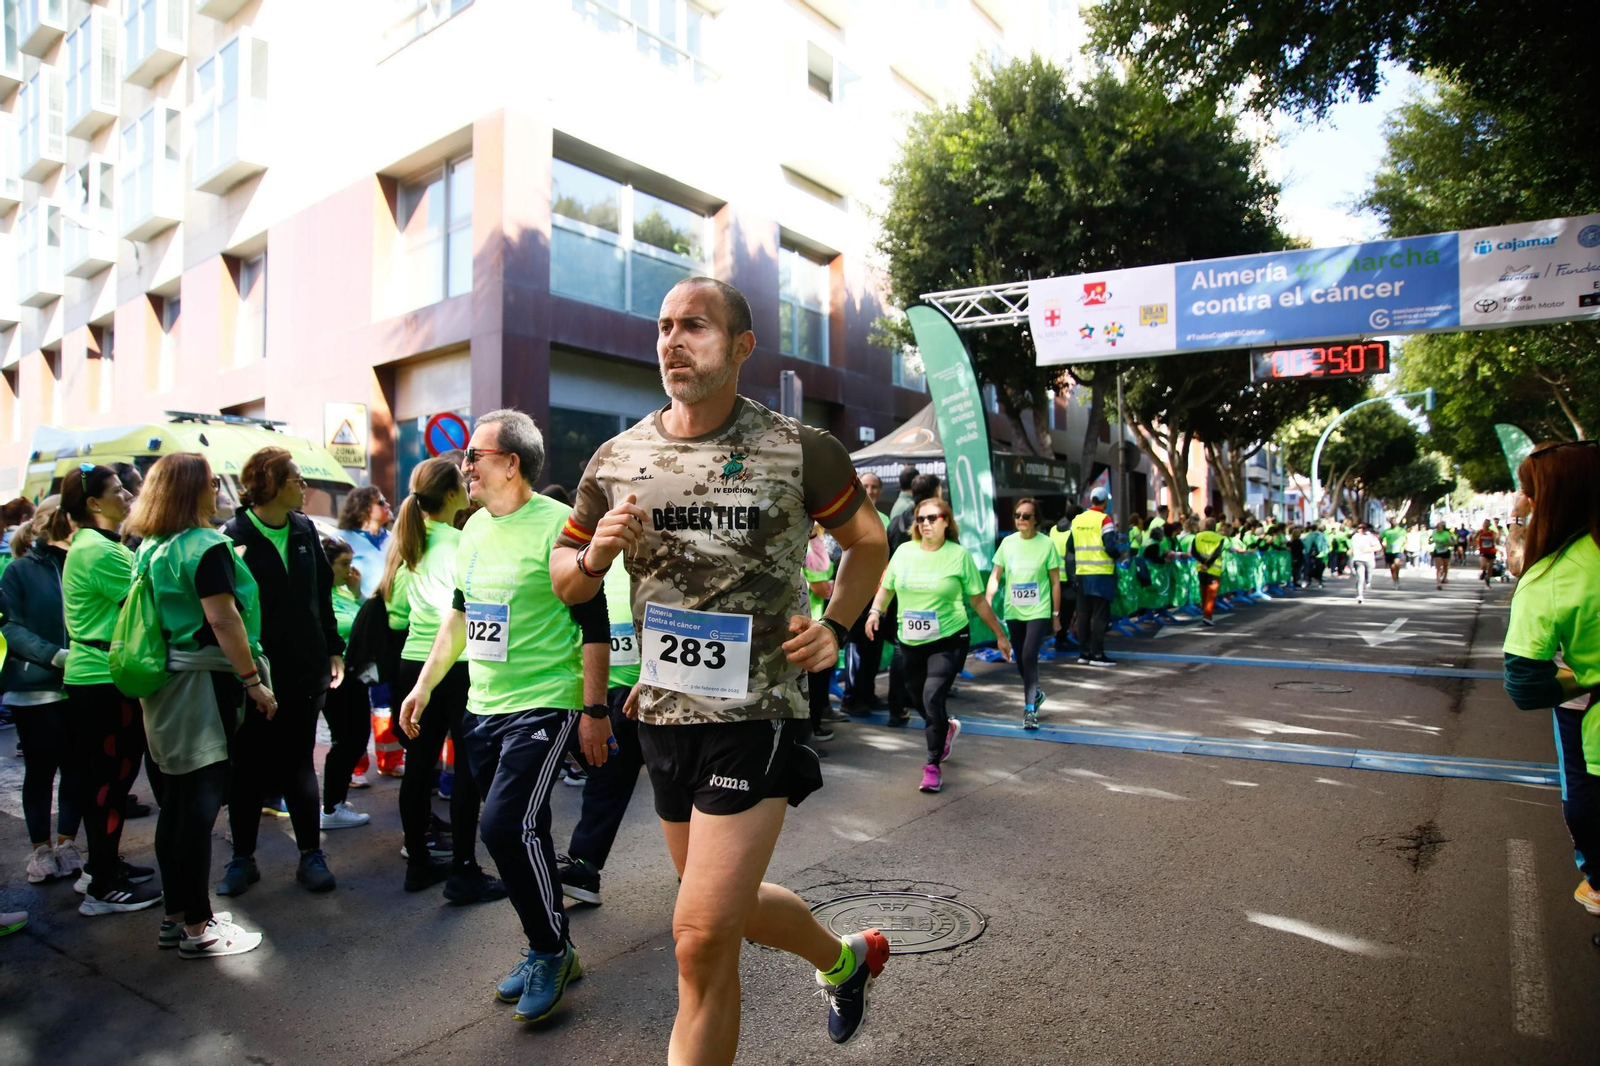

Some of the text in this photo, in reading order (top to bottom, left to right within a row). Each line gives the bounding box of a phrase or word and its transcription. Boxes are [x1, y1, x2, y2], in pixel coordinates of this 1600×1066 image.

[1496, 236, 1558, 252] cajamar
[1191, 247, 1441, 291] Almería en marcha
[1499, 272, 1540, 282] MICHELIN
[1191, 280, 1405, 316] contra el cáncer
[1502, 296, 1532, 304] Toyota
[1538, 301, 1565, 309] Motor
[335, 447, 355, 455] ZONA
[723, 486, 753, 494] EDICIÓN
[1012, 590, 1037, 599] 1025
[647, 616, 668, 625] contra
[676, 621, 701, 631] cáncer
[908, 620, 931, 630] 905
[466, 621, 501, 642] 022
[659, 634, 726, 670] 283
[531, 734, 549, 742] adidas
